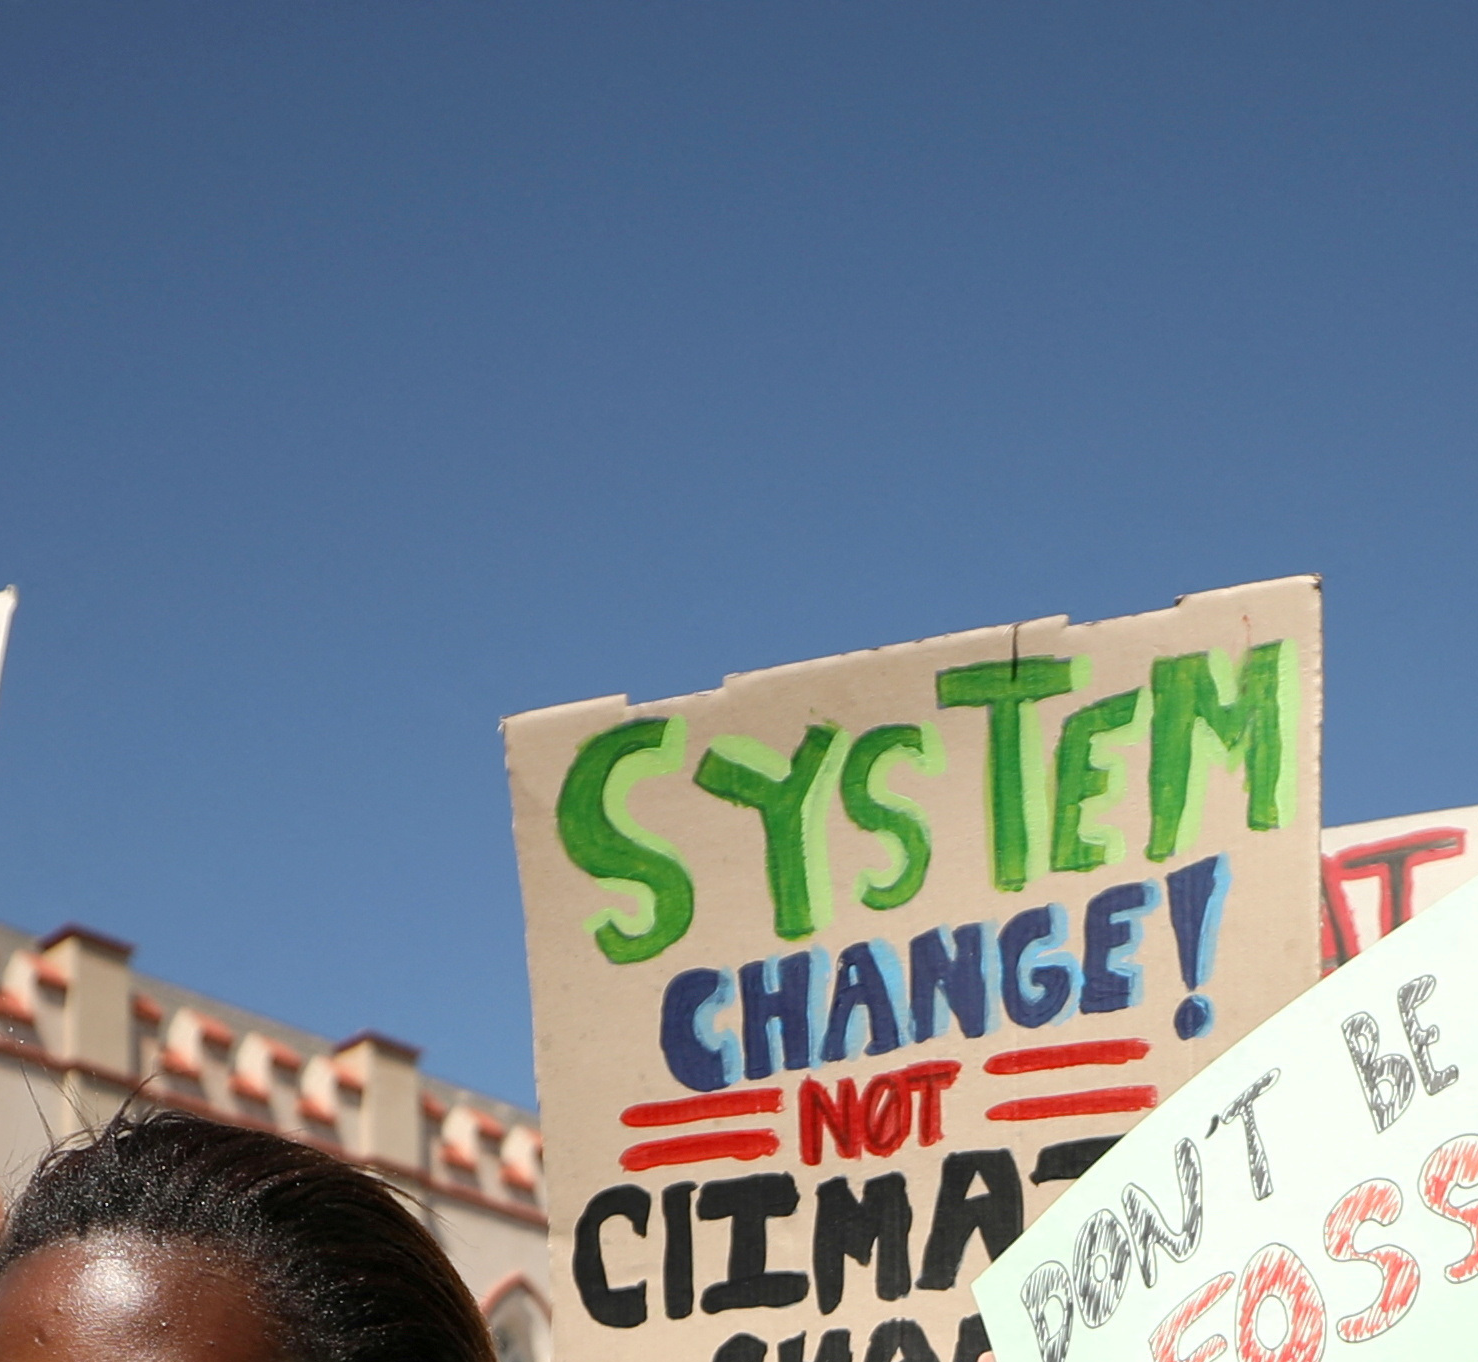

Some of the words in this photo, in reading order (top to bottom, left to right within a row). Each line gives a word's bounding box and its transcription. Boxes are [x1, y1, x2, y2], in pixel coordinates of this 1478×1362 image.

[555, 638, 1298, 965] SYSTEM
[659, 852, 1232, 1092] CHANGE!
[1341, 974, 1460, 1135] BE
[798, 1059, 963, 1166] NOT
